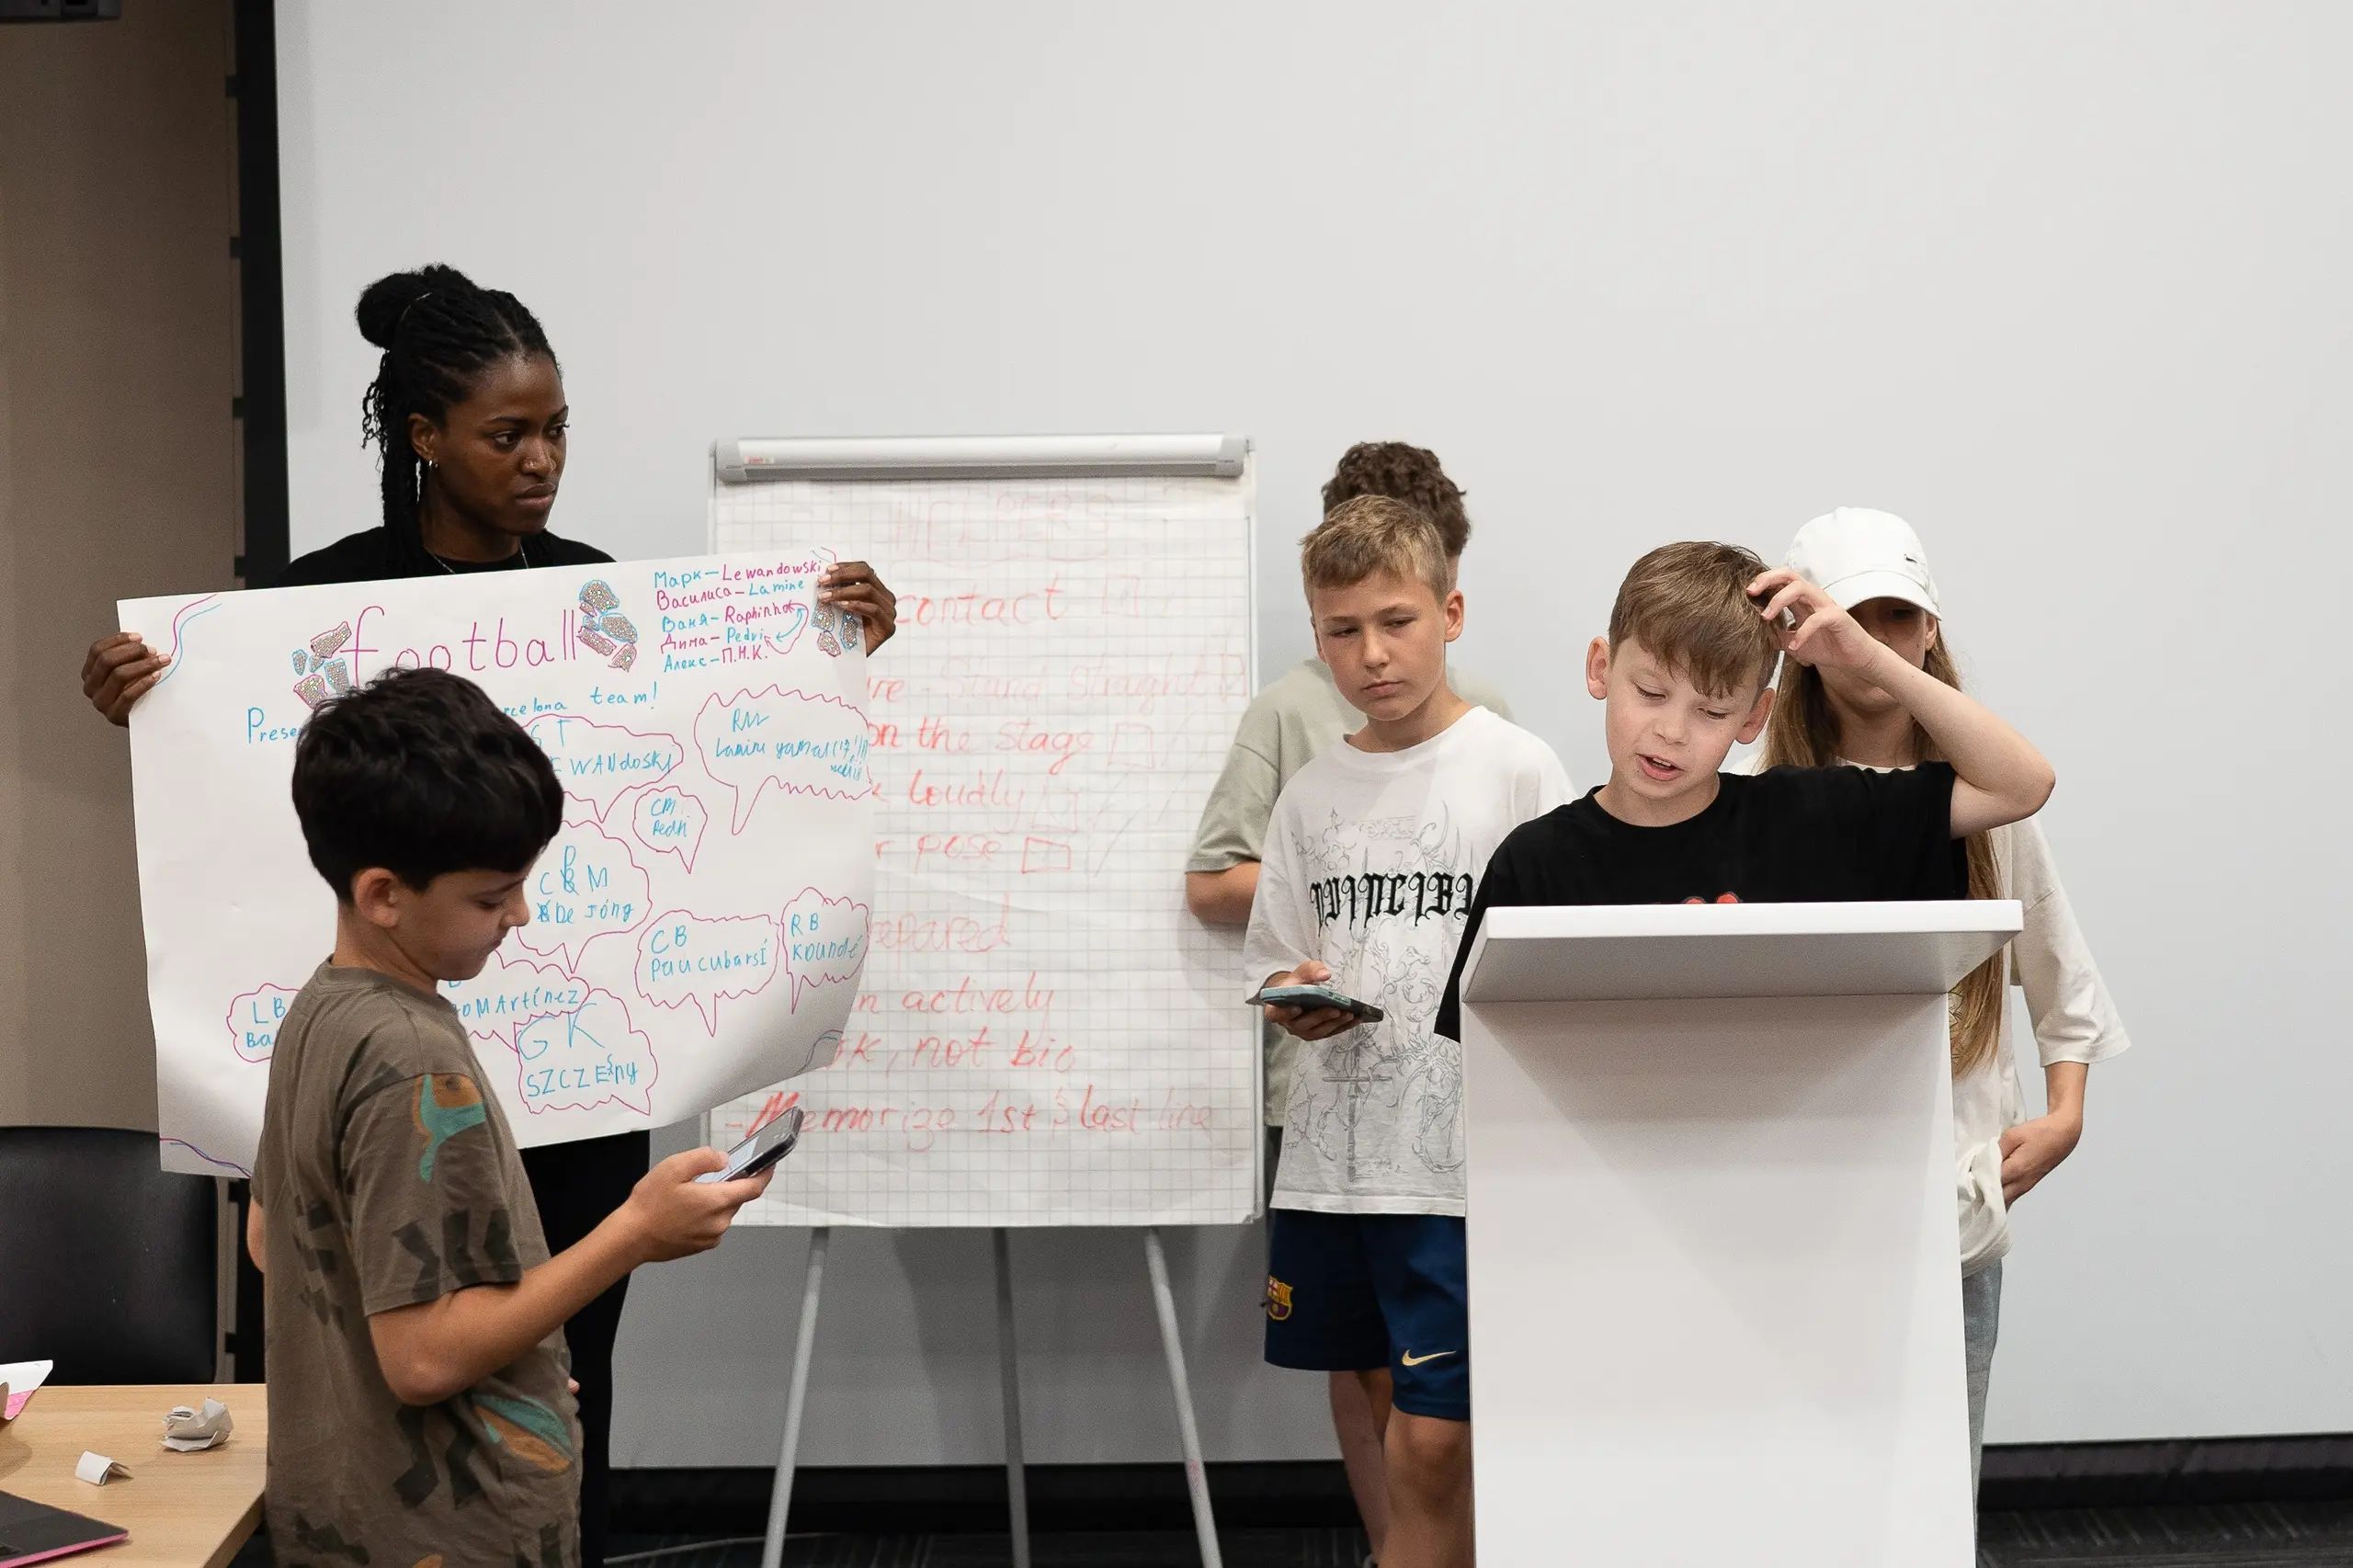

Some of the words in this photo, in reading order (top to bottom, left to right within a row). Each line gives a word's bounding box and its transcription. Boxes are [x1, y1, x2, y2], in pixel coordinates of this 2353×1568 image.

[247, 707, 301, 744] Prese
[504, 698, 568, 717] rcelona
[918, 716, 978, 755] the
[1079, 1084, 1147, 1135] last
